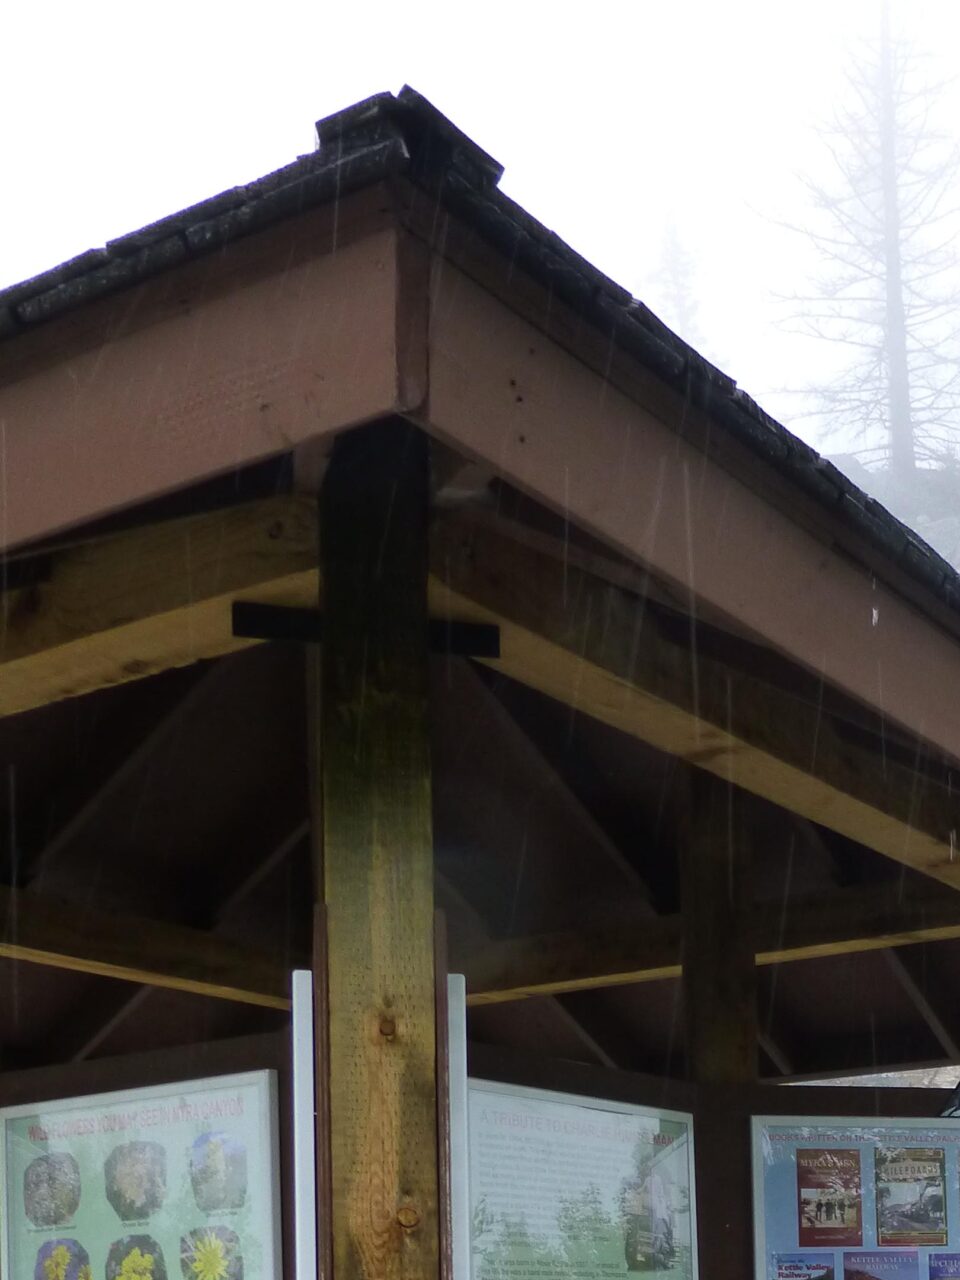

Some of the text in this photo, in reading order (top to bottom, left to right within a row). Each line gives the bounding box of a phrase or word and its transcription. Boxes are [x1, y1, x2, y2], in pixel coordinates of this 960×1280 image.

[491, 1110, 543, 1130] TRIBUTE
[806, 1263, 832, 1271] Valley
[777, 1272, 812, 1280] Railway
